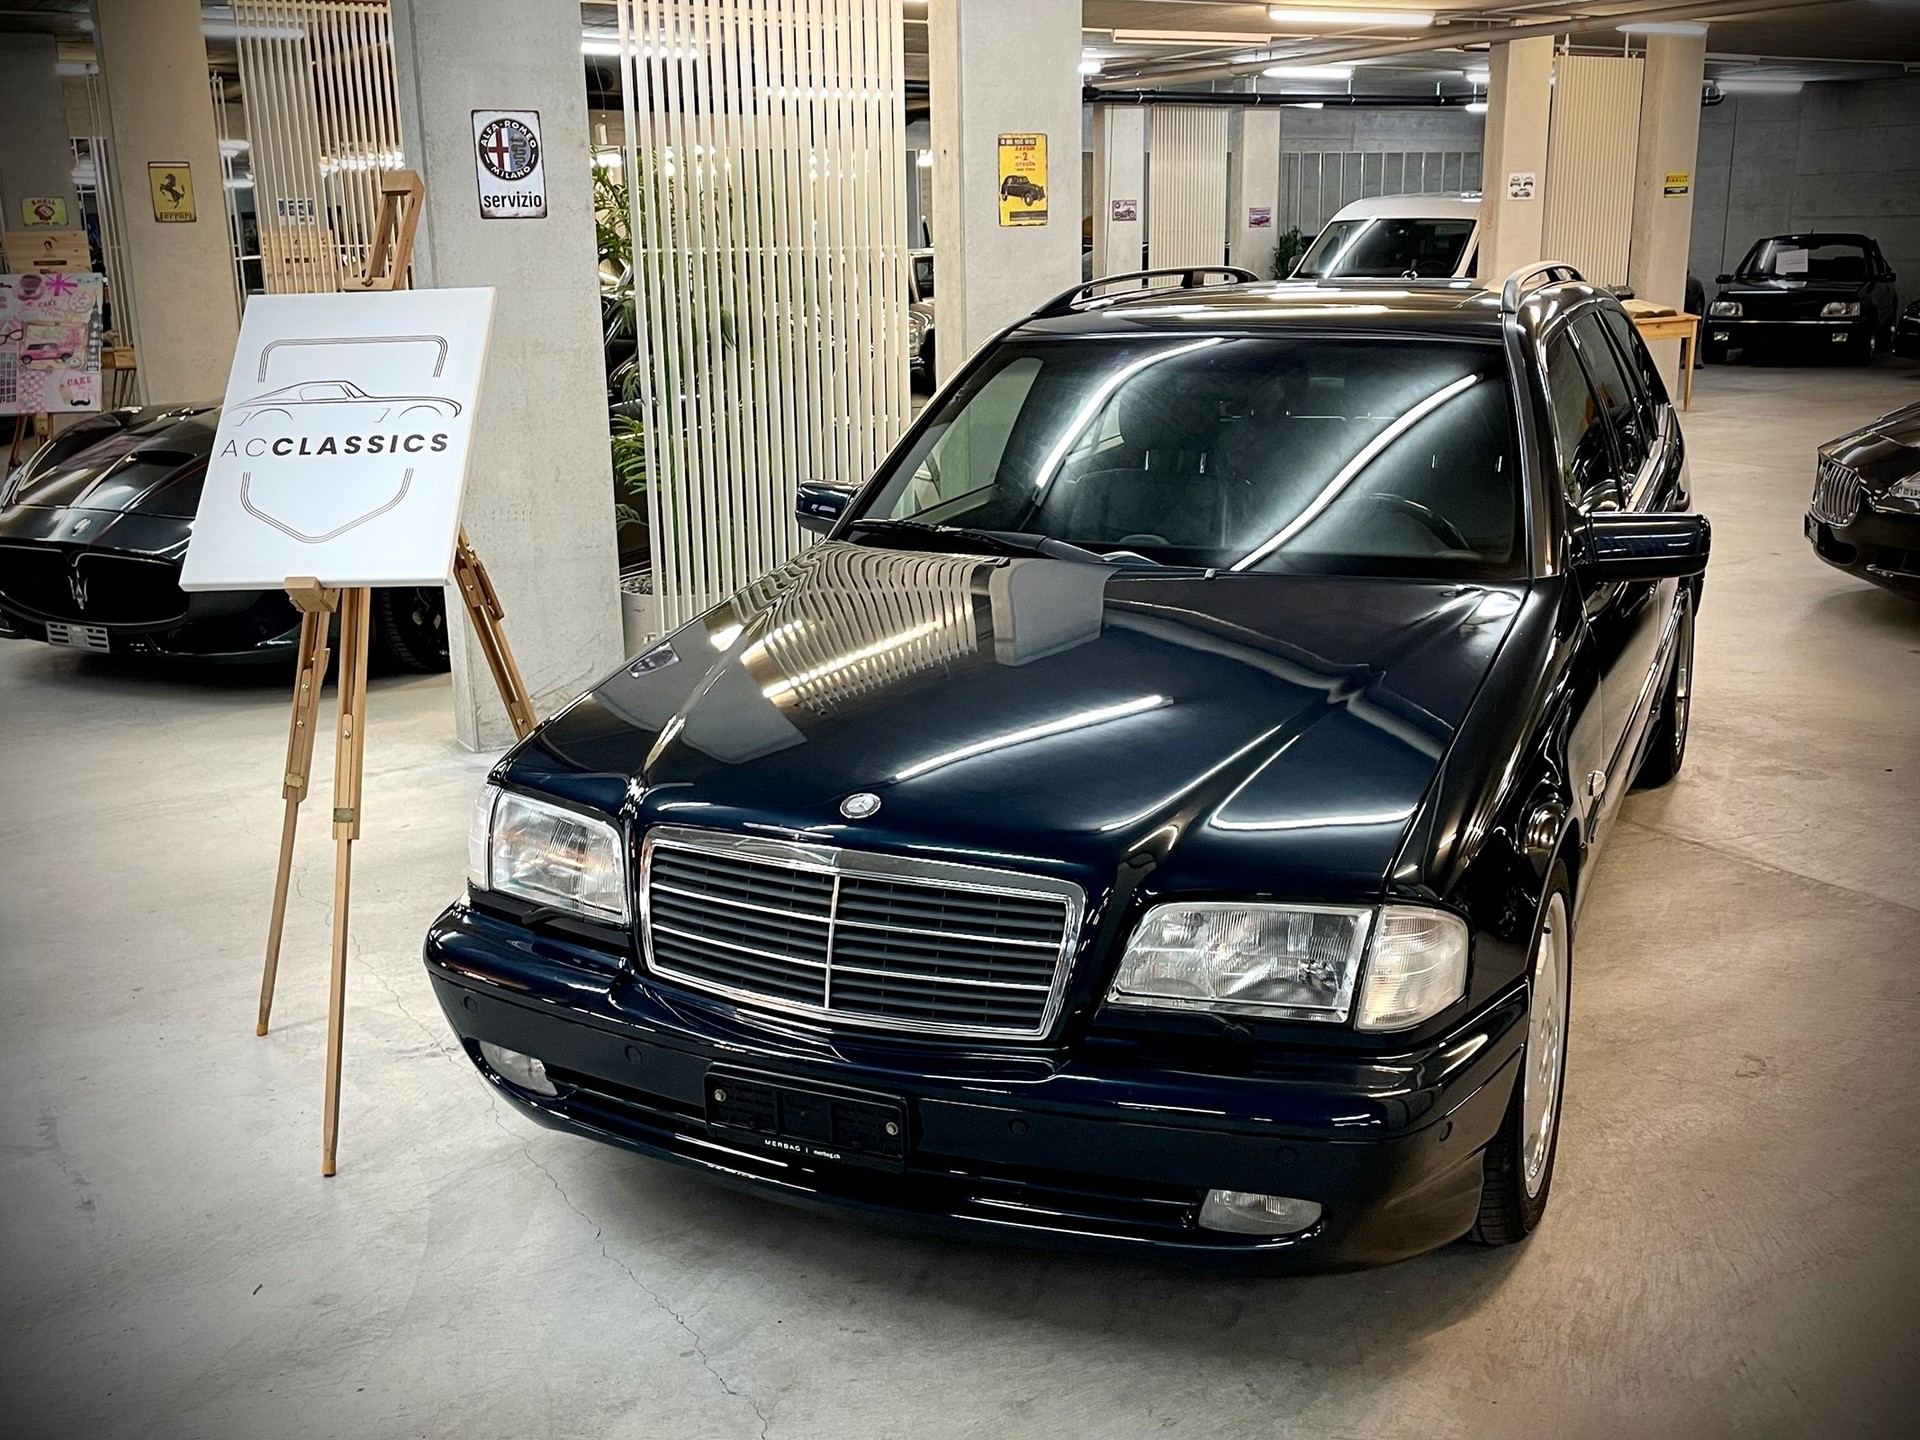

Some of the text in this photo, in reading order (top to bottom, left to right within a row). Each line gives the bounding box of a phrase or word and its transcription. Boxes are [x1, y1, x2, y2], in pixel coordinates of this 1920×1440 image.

[491, 165, 531, 179] MILANO
[483, 191, 542, 209] servizio
[67, 376, 93, 386] CAKE
